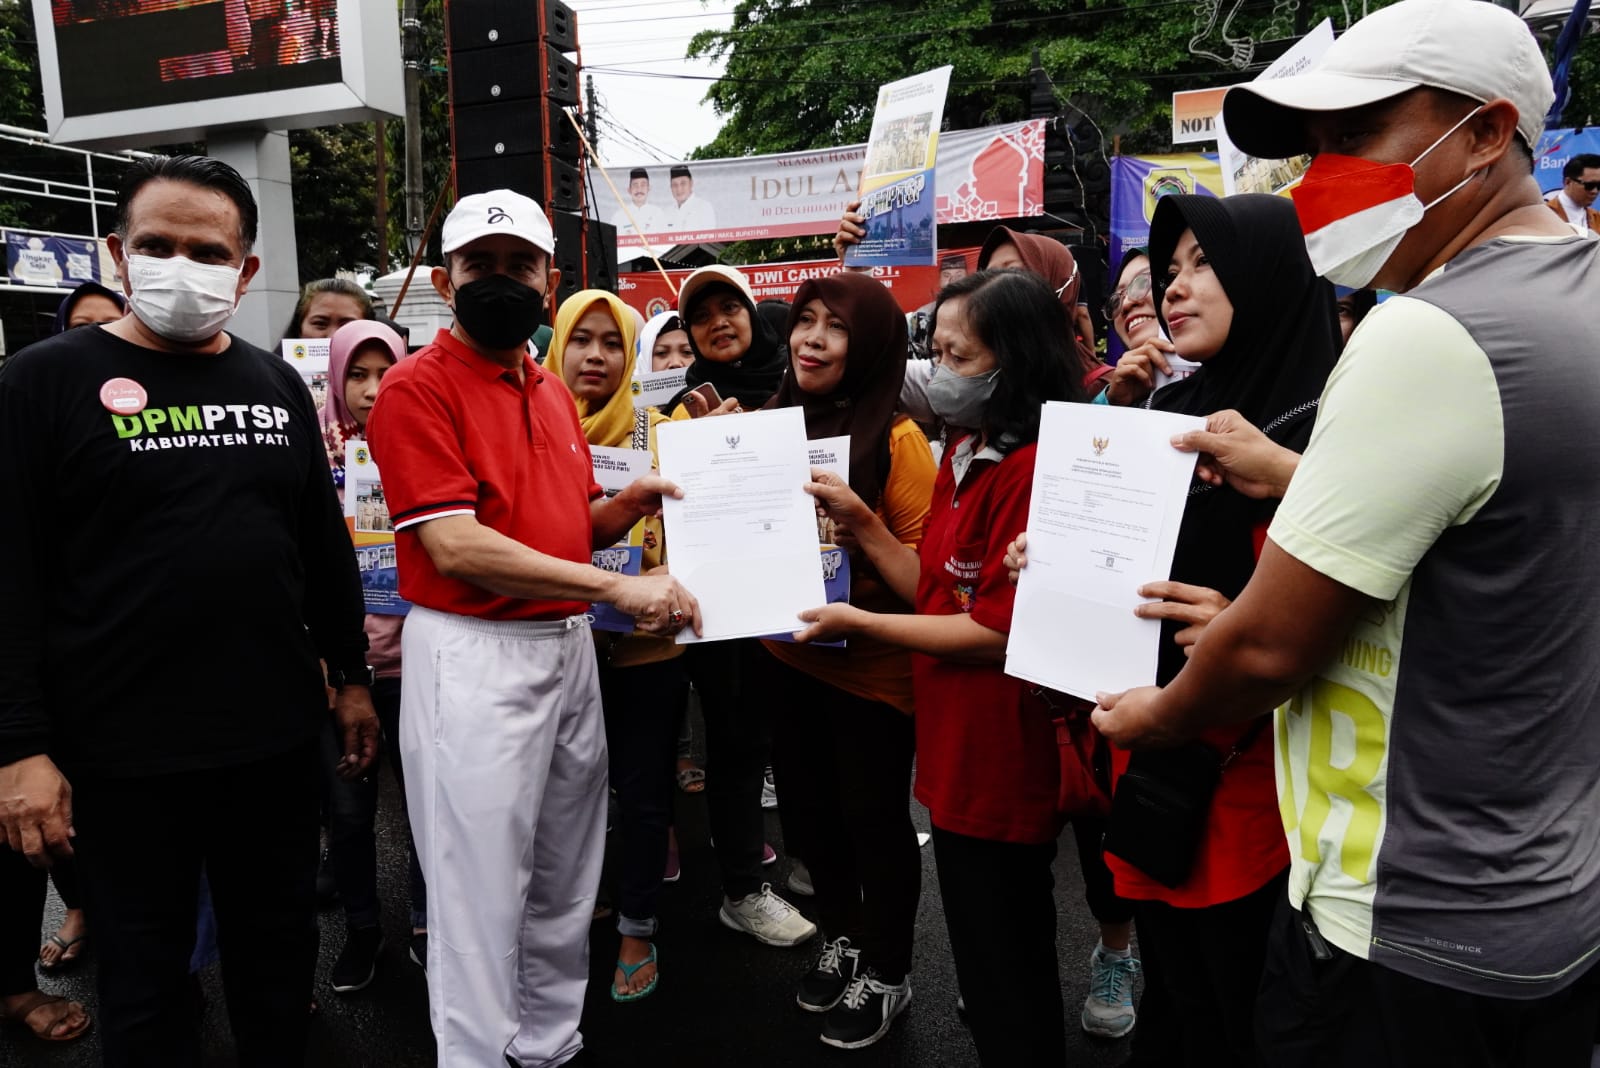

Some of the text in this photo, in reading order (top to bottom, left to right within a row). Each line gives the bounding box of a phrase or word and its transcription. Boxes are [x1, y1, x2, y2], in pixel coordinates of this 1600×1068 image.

[1180, 115, 1215, 134] NOT
[777, 151, 859, 168] SELAMAT HARI
[750, 174, 819, 201] IDUL
[754, 271, 783, 285] DWI
[788, 263, 847, 282] CAHYO
[762, 285, 792, 295] PROVINSI
[112, 404, 290, 439] DPMPTSP
[130, 433, 290, 452] KABUPATEN PATI
[1339, 639, 1392, 678] NING
